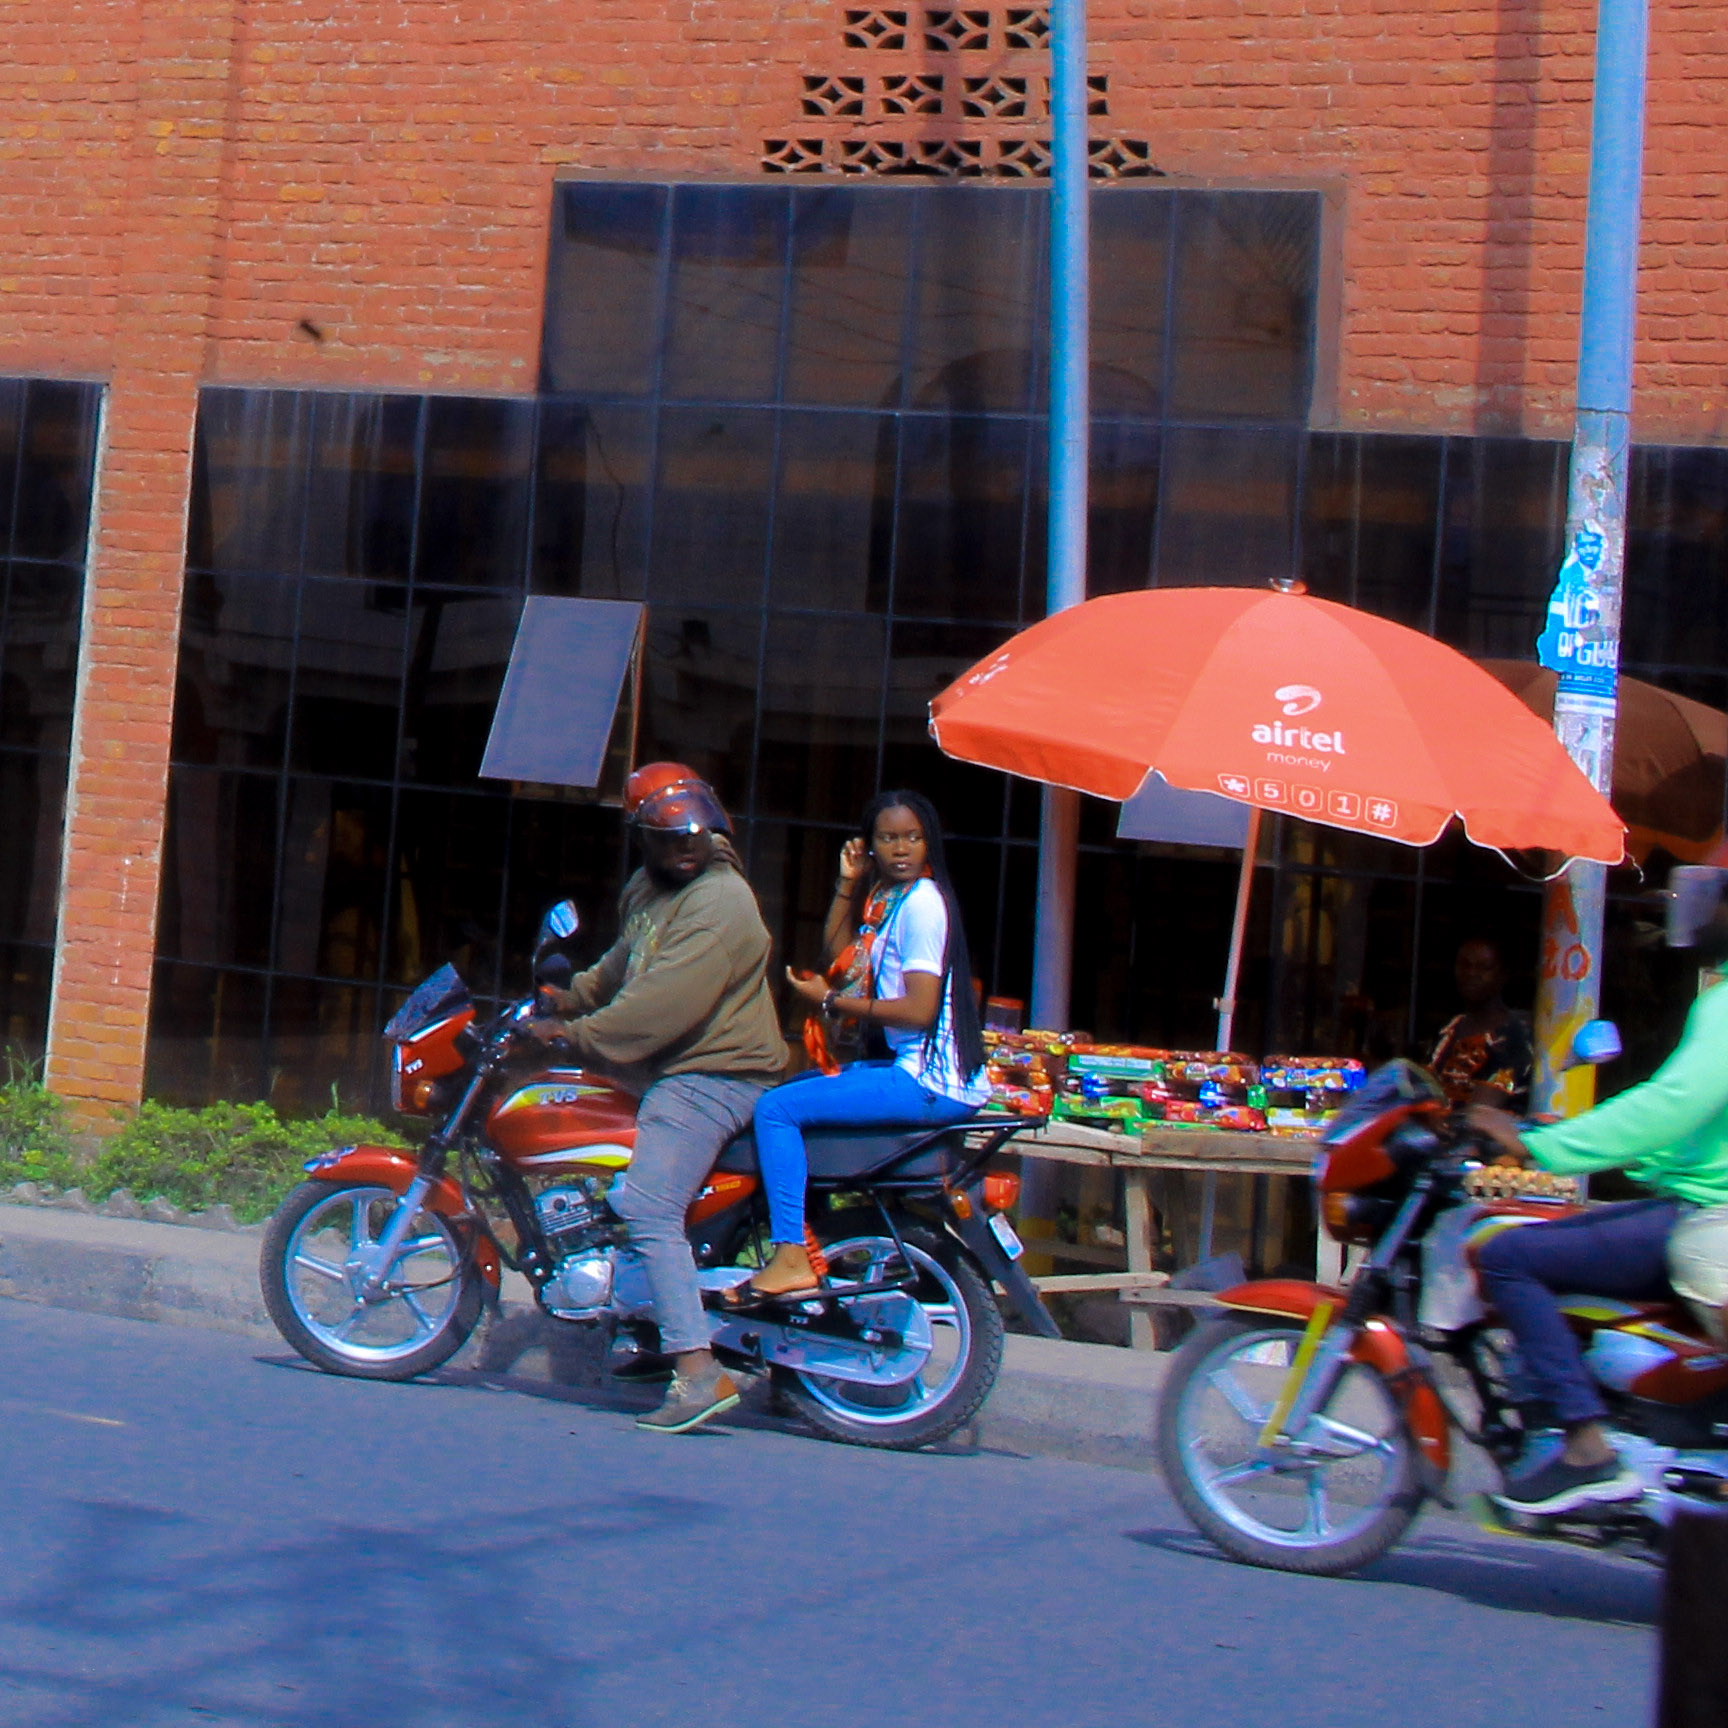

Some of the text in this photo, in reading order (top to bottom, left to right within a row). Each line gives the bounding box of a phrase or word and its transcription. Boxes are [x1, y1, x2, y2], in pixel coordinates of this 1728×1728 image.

[1251, 720, 1346, 755] airtel
[1266, 751, 1332, 772] money
[539, 1087, 578, 1105] TVS
